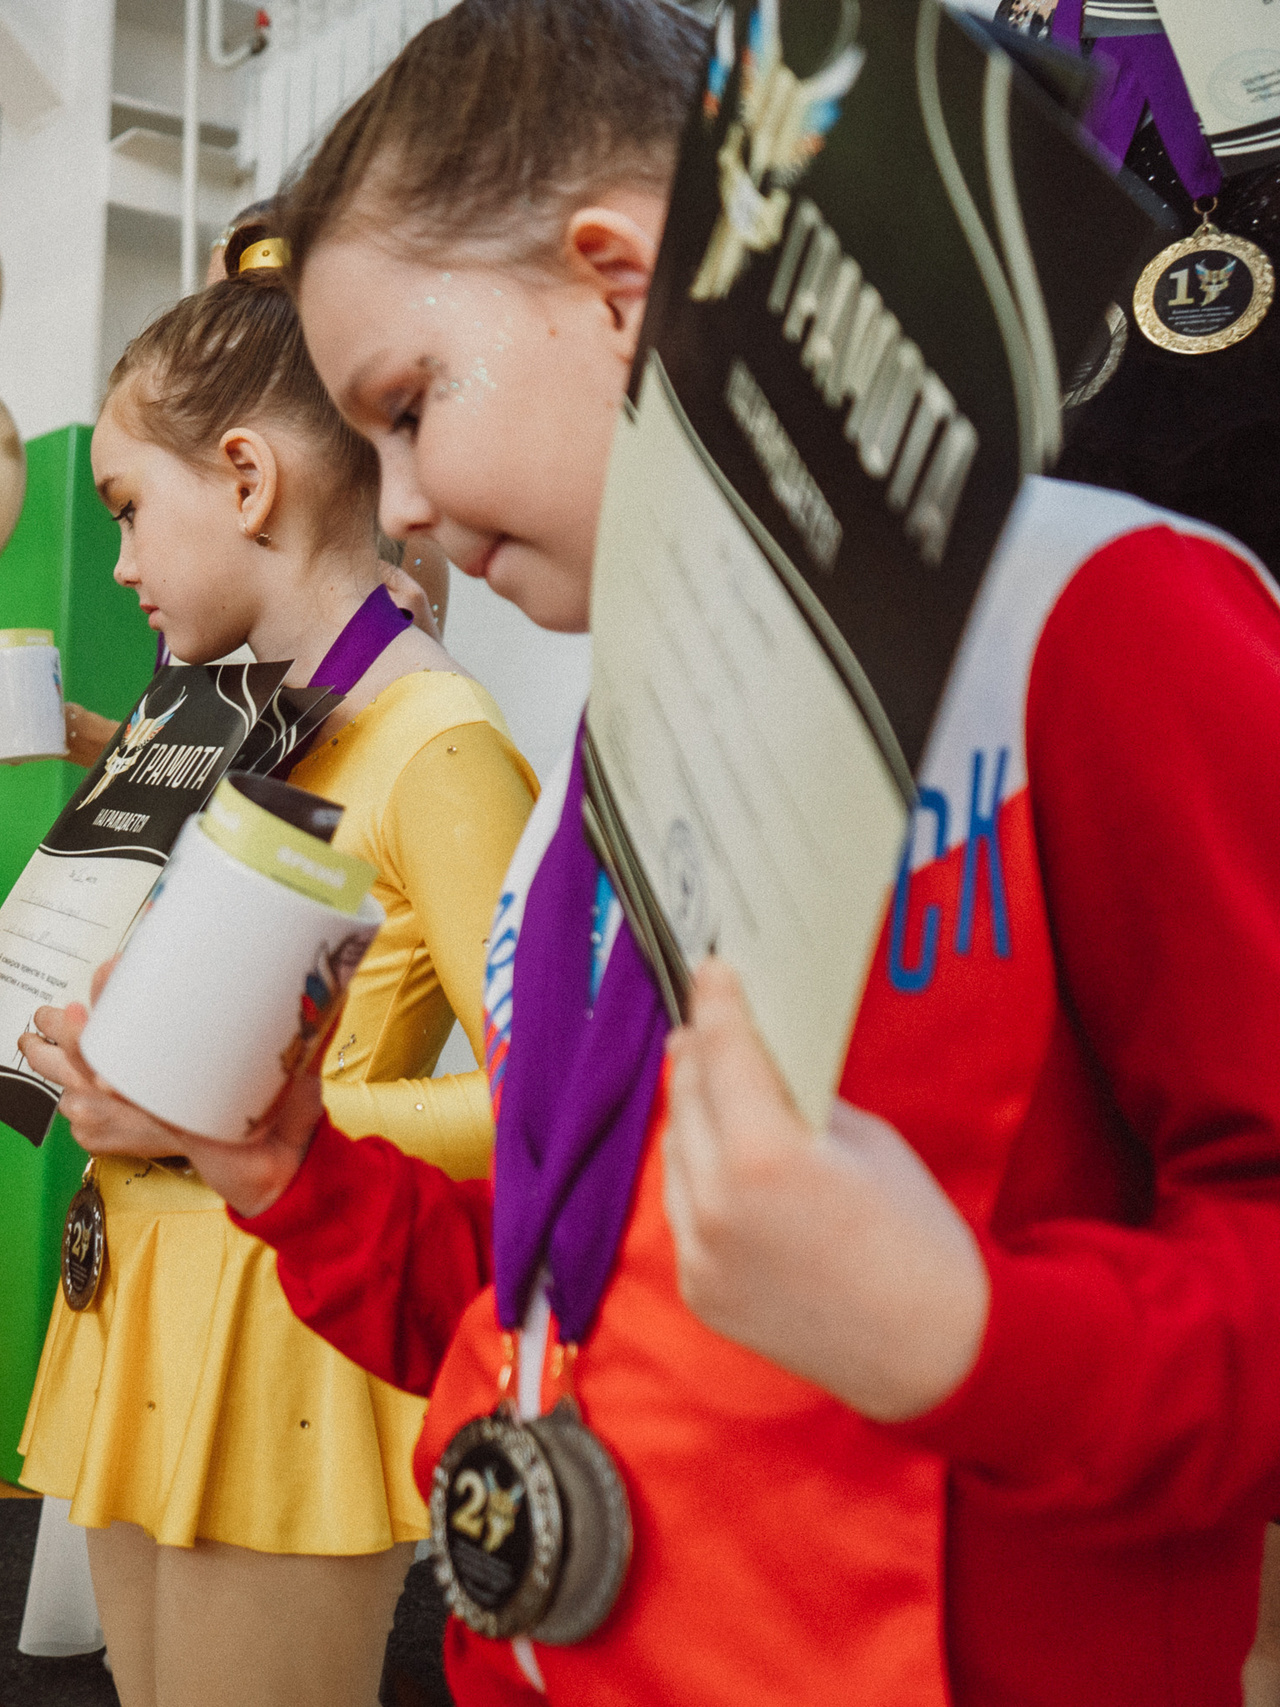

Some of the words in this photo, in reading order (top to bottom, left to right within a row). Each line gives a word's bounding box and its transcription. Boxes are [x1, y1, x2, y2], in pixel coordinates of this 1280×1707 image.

[1167, 269, 1195, 306] 1
[128, 743, 224, 790] ГРАМОТА
[72, 1221, 82, 1256] 2
[451, 1469, 488, 1538] 2
